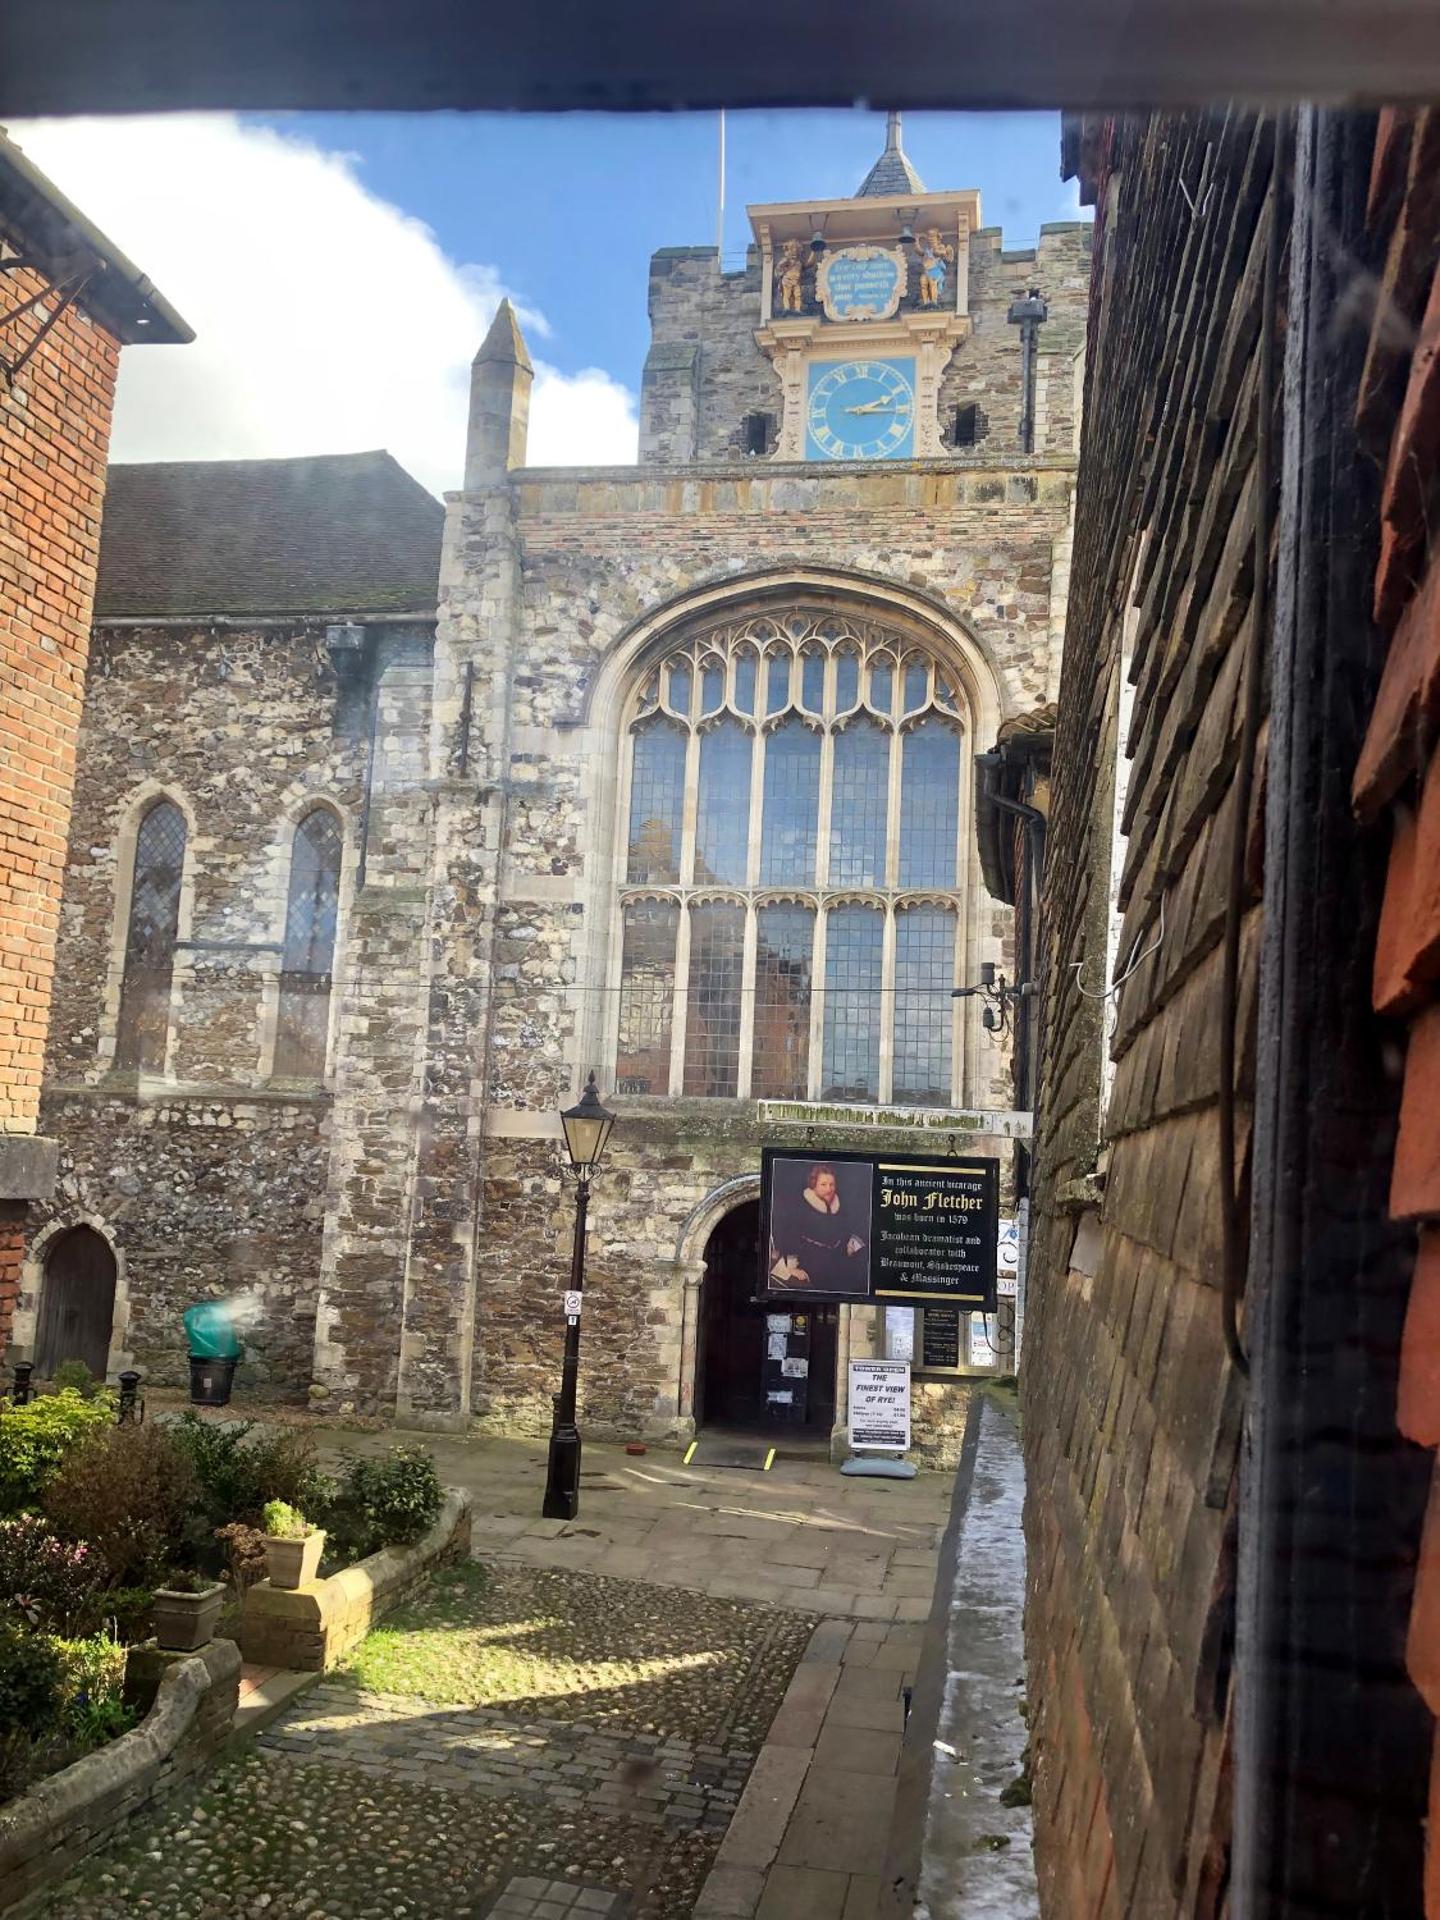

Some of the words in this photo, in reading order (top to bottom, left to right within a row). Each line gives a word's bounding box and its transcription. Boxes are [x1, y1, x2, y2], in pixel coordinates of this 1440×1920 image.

[882, 1176, 894, 1186] In
[896, 1177, 912, 1188] this
[915, 1178, 945, 1189] ancient
[946, 1180, 982, 1192] vicarage
[880, 1188, 917, 1209] John
[922, 1192, 983, 1212] Fletcher
[894, 1212, 911, 1221] was
[914, 1213, 934, 1223] born
[936, 1215, 946, 1223] in
[948, 1215, 968, 1225] 1579
[880, 1230, 919, 1241] Jacobean
[922, 1233, 963, 1244] dramatist
[965, 1236, 981, 1245] and
[895, 1245, 945, 1256] collaborator
[947, 1248, 966, 1258] with
[880, 1257, 925, 1269] Beaumont,
[900, 1272, 908, 1282] &
[911, 1273, 959, 1285] Massinger
